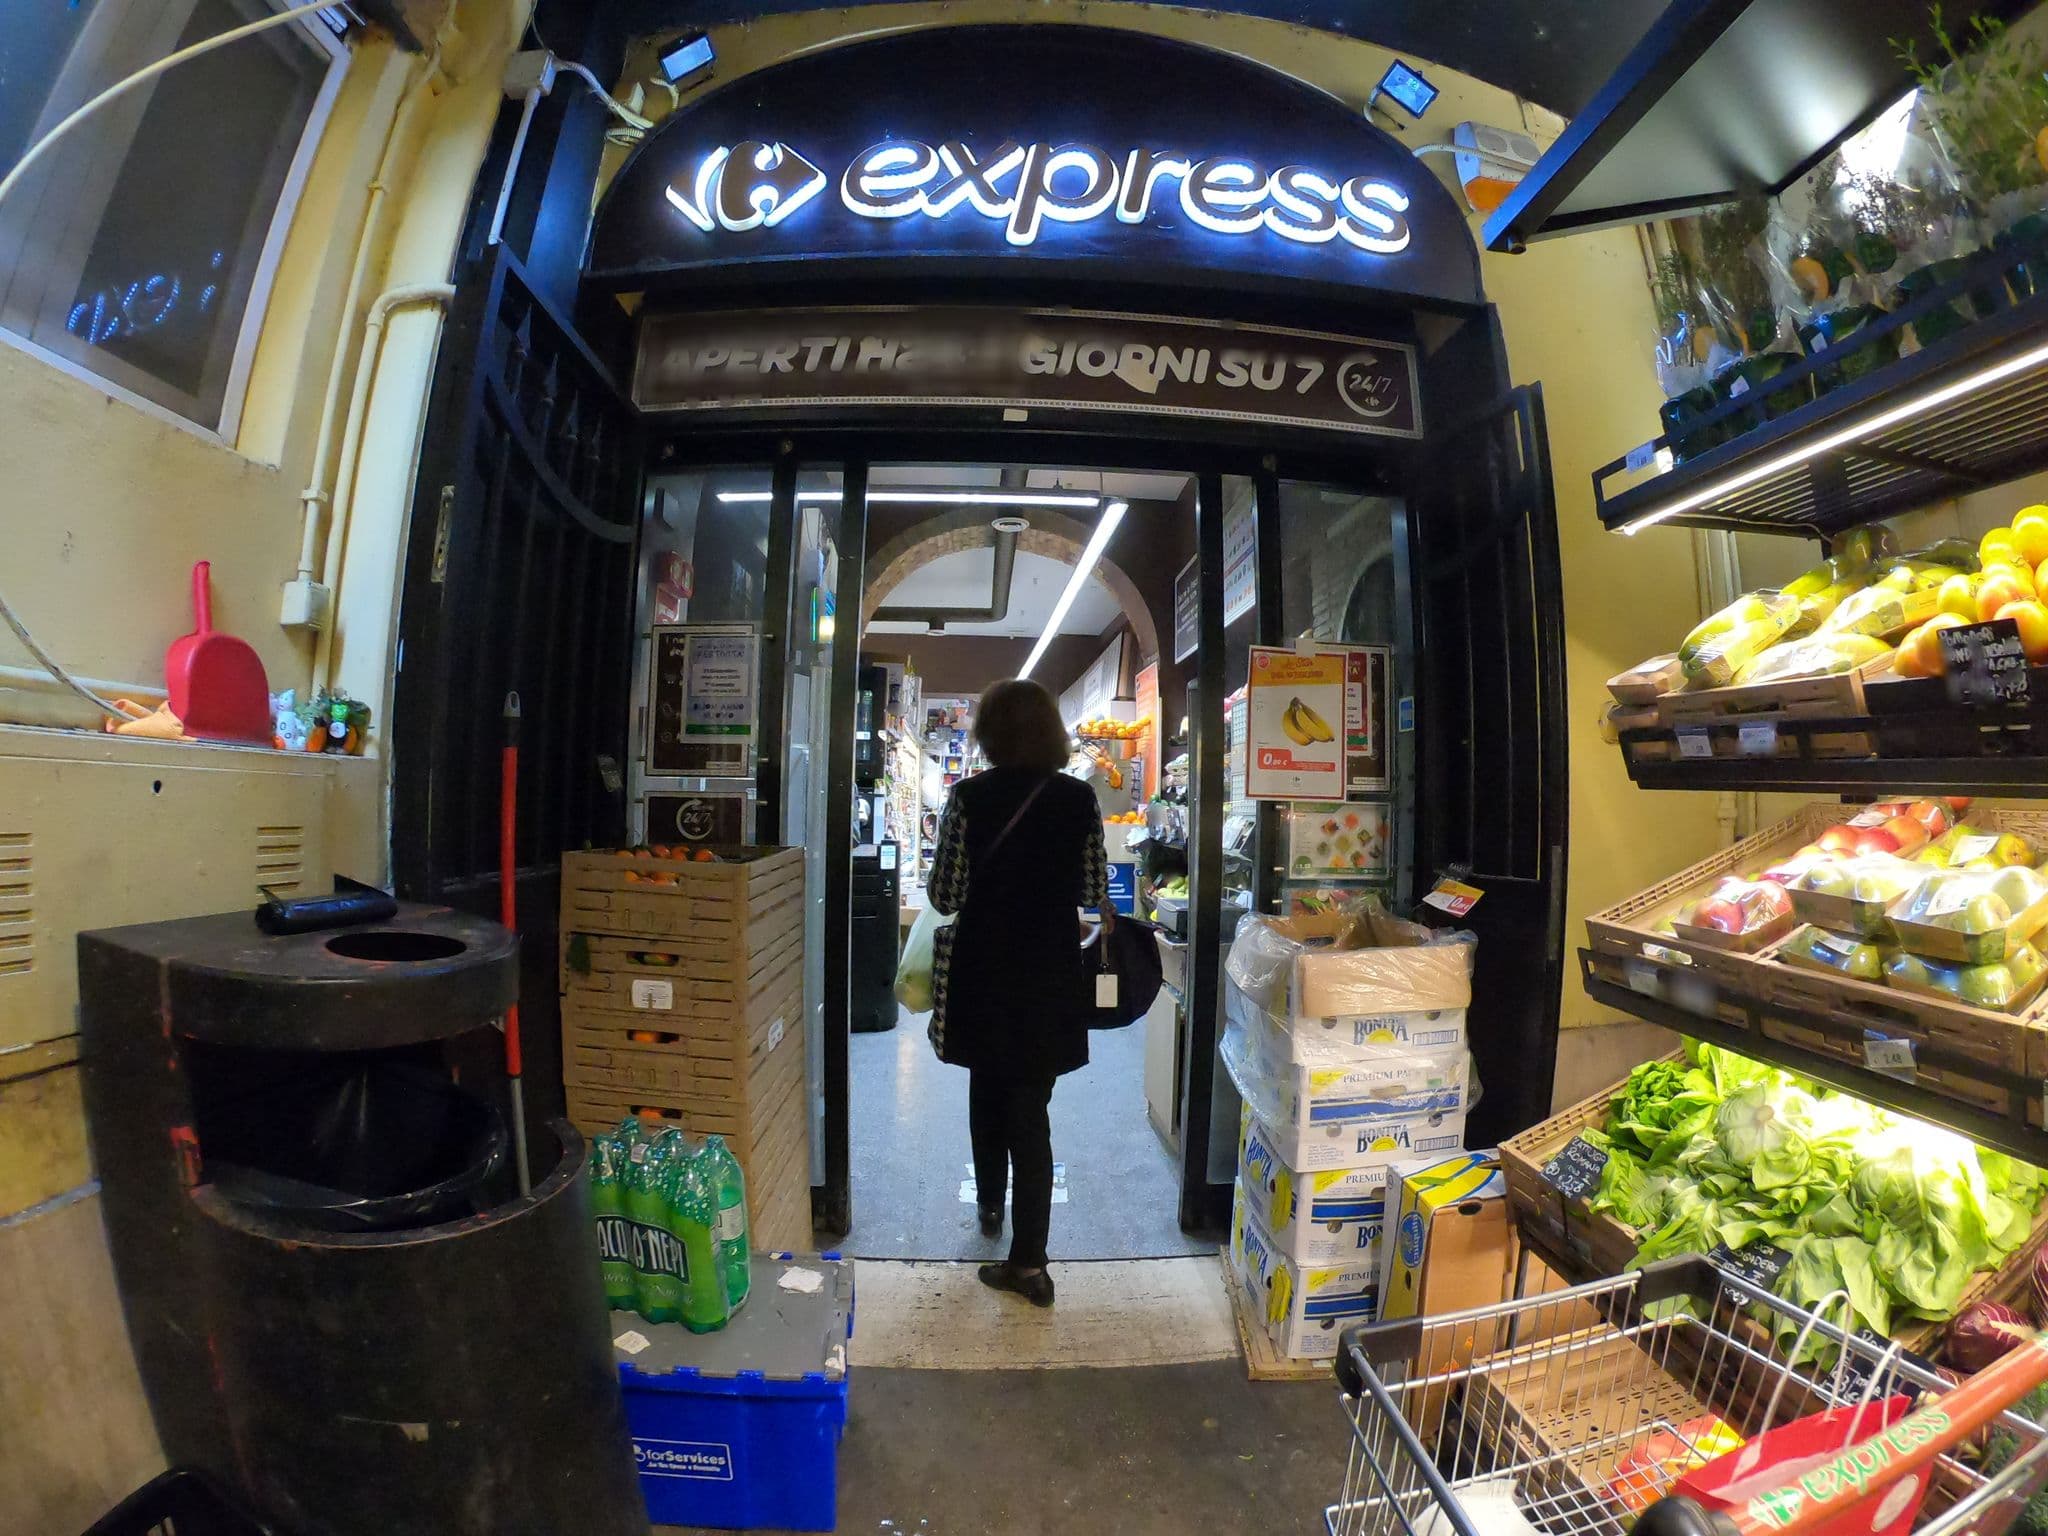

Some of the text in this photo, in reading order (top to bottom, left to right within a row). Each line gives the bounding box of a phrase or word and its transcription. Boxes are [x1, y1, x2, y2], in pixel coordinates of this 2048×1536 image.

[841, 138, 1411, 253] express
[1020, 337, 1211, 388] GIORNI
[1216, 349, 1287, 391] SU
[1295, 358, 1325, 395] 7
[1348, 372, 1393, 395] 24/7
[683, 812, 712, 824] 24/7
[1353, 1015, 1410, 1045] BONITA
[1343, 1070, 1393, 1084] PREMIUM
[1356, 1124, 1410, 1153] BONITA
[1246, 1136, 1273, 1192] BONITA
[1346, 1173, 1385, 1184] PREMIU
[647, 1229, 685, 1278] NEPI
[1245, 1225, 1268, 1288] BONITA
[1798, 1405, 1952, 1504] express
